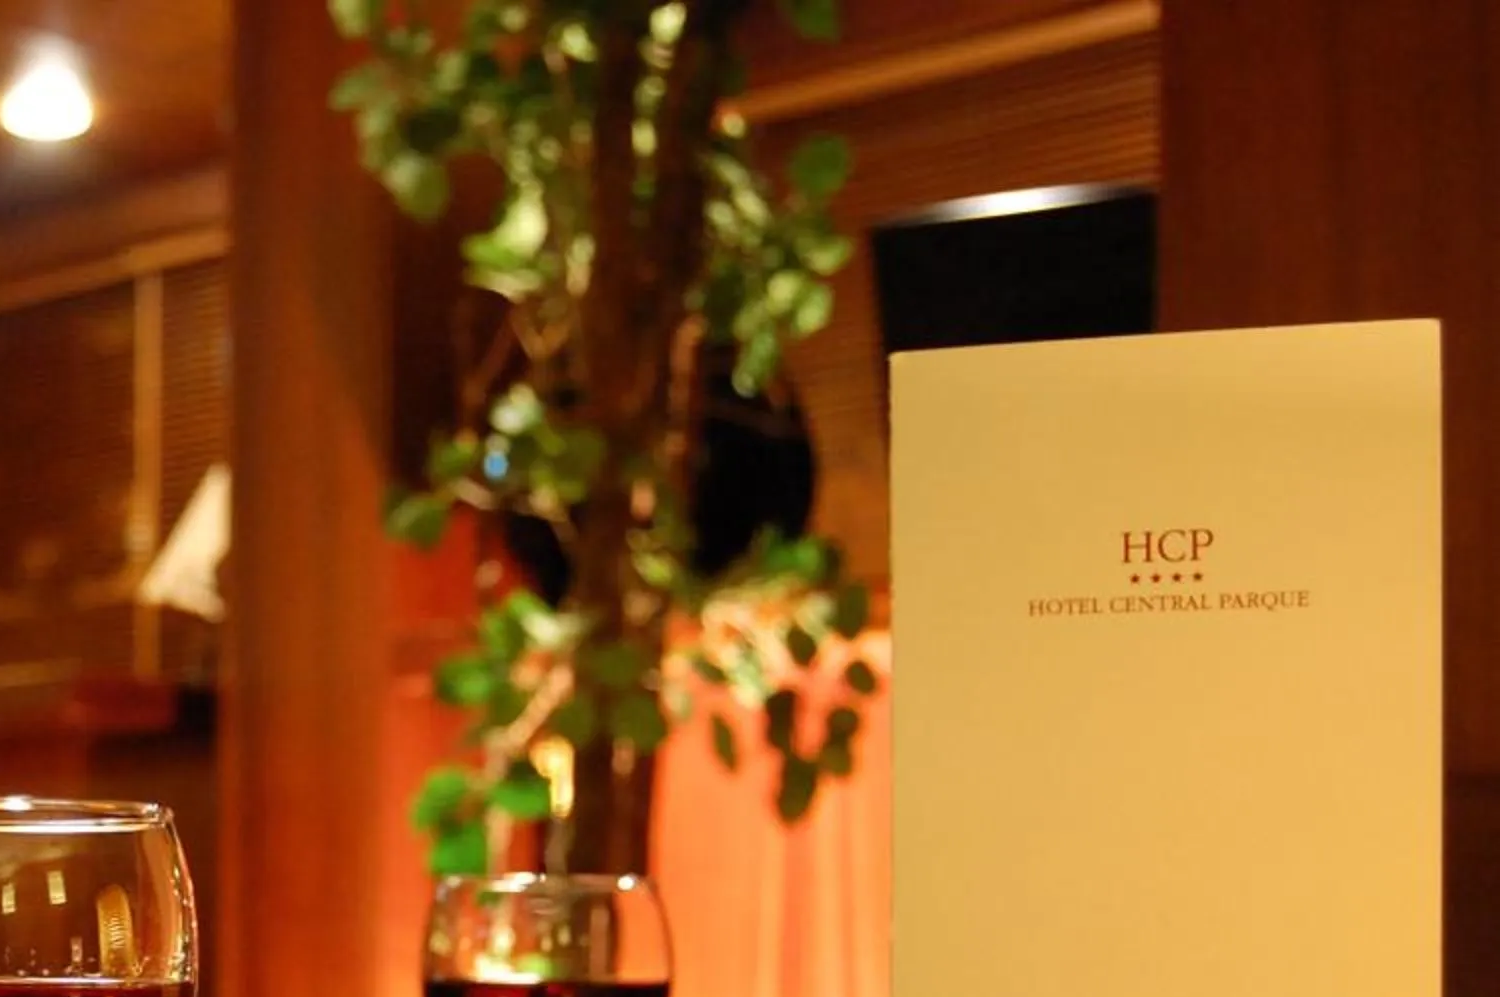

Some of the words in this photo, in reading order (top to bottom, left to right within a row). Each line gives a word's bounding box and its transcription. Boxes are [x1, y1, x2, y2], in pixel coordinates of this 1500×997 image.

[1121, 528, 1214, 564] HCP
[1028, 599, 1102, 617] HOTEL
[1109, 594, 1212, 615] CENTRAL
[1219, 590, 1311, 612] PARQUE
